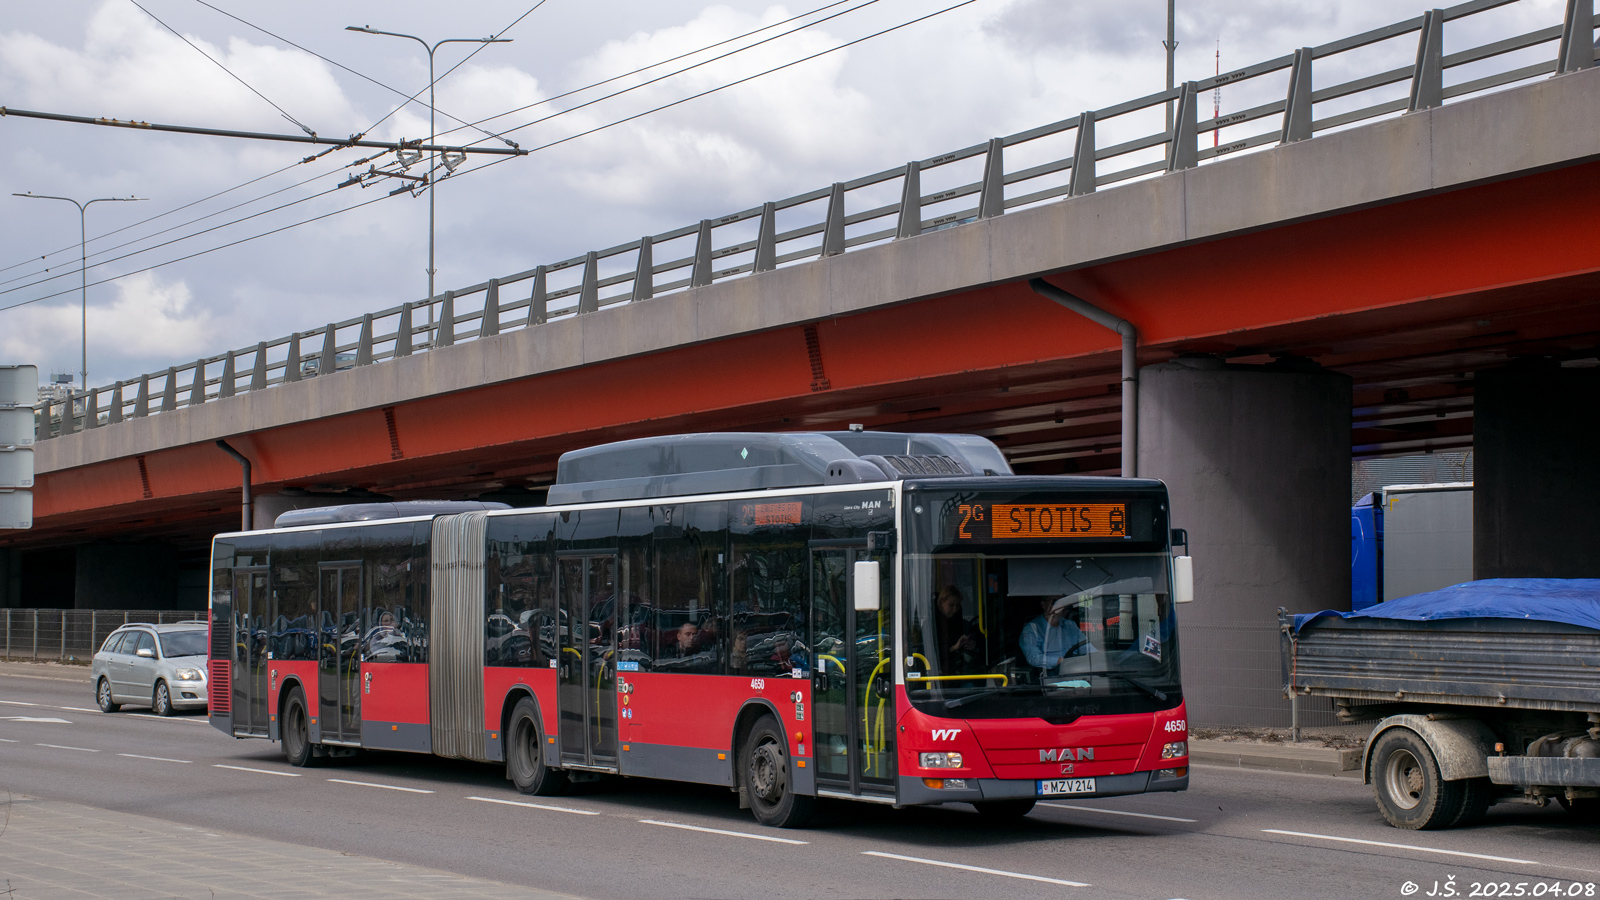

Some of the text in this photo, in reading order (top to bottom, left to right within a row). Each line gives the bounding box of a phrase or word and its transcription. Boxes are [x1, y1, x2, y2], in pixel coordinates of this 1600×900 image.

[861, 500, 881, 509] MAN
[766, 513, 792, 525] STOTIS
[958, 504, 1092, 539] 2G STOTIS
[750, 678, 765, 690] 4650
[1164, 719, 1186, 733] 4650
[1039, 747, 1094, 763] MAN
[1050, 780, 1074, 793] MZV
[1075, 779, 1093, 792] 214
